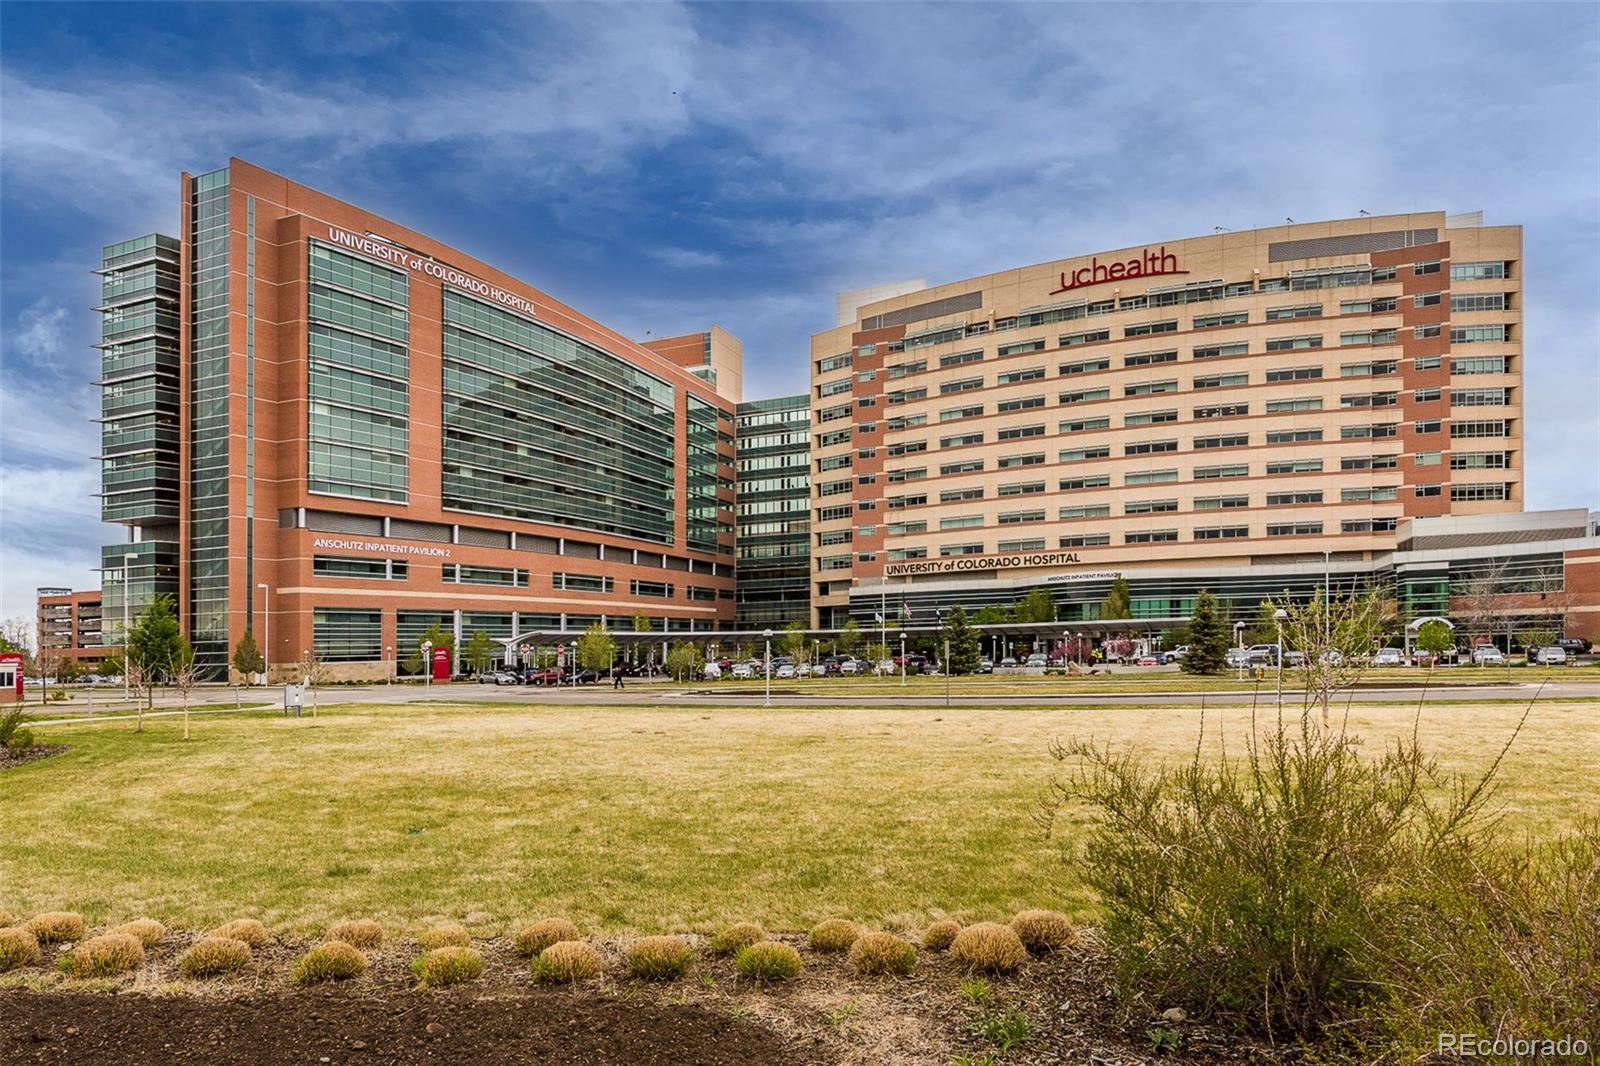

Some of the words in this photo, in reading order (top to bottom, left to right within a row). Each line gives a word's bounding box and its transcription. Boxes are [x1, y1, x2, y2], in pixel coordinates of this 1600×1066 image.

[328, 227, 408, 266] UNIVERSITY
[410, 259, 423, 271] of
[424, 263, 490, 297] COLORADO
[490, 287, 536, 316] HOSPITAL
[1060, 246, 1177, 289] uchealth
[313, 538, 363, 551] ANSCHUTZ
[364, 542, 408, 554] INPATIENT
[409, 547, 445, 557] PAVILION
[445, 549, 451, 557] 2
[886, 562, 943, 575] UNIVERSITY
[944, 560, 955, 571] of
[957, 556, 1021, 570] COLORADO
[1023, 553, 1080, 566] HOSPITAL
